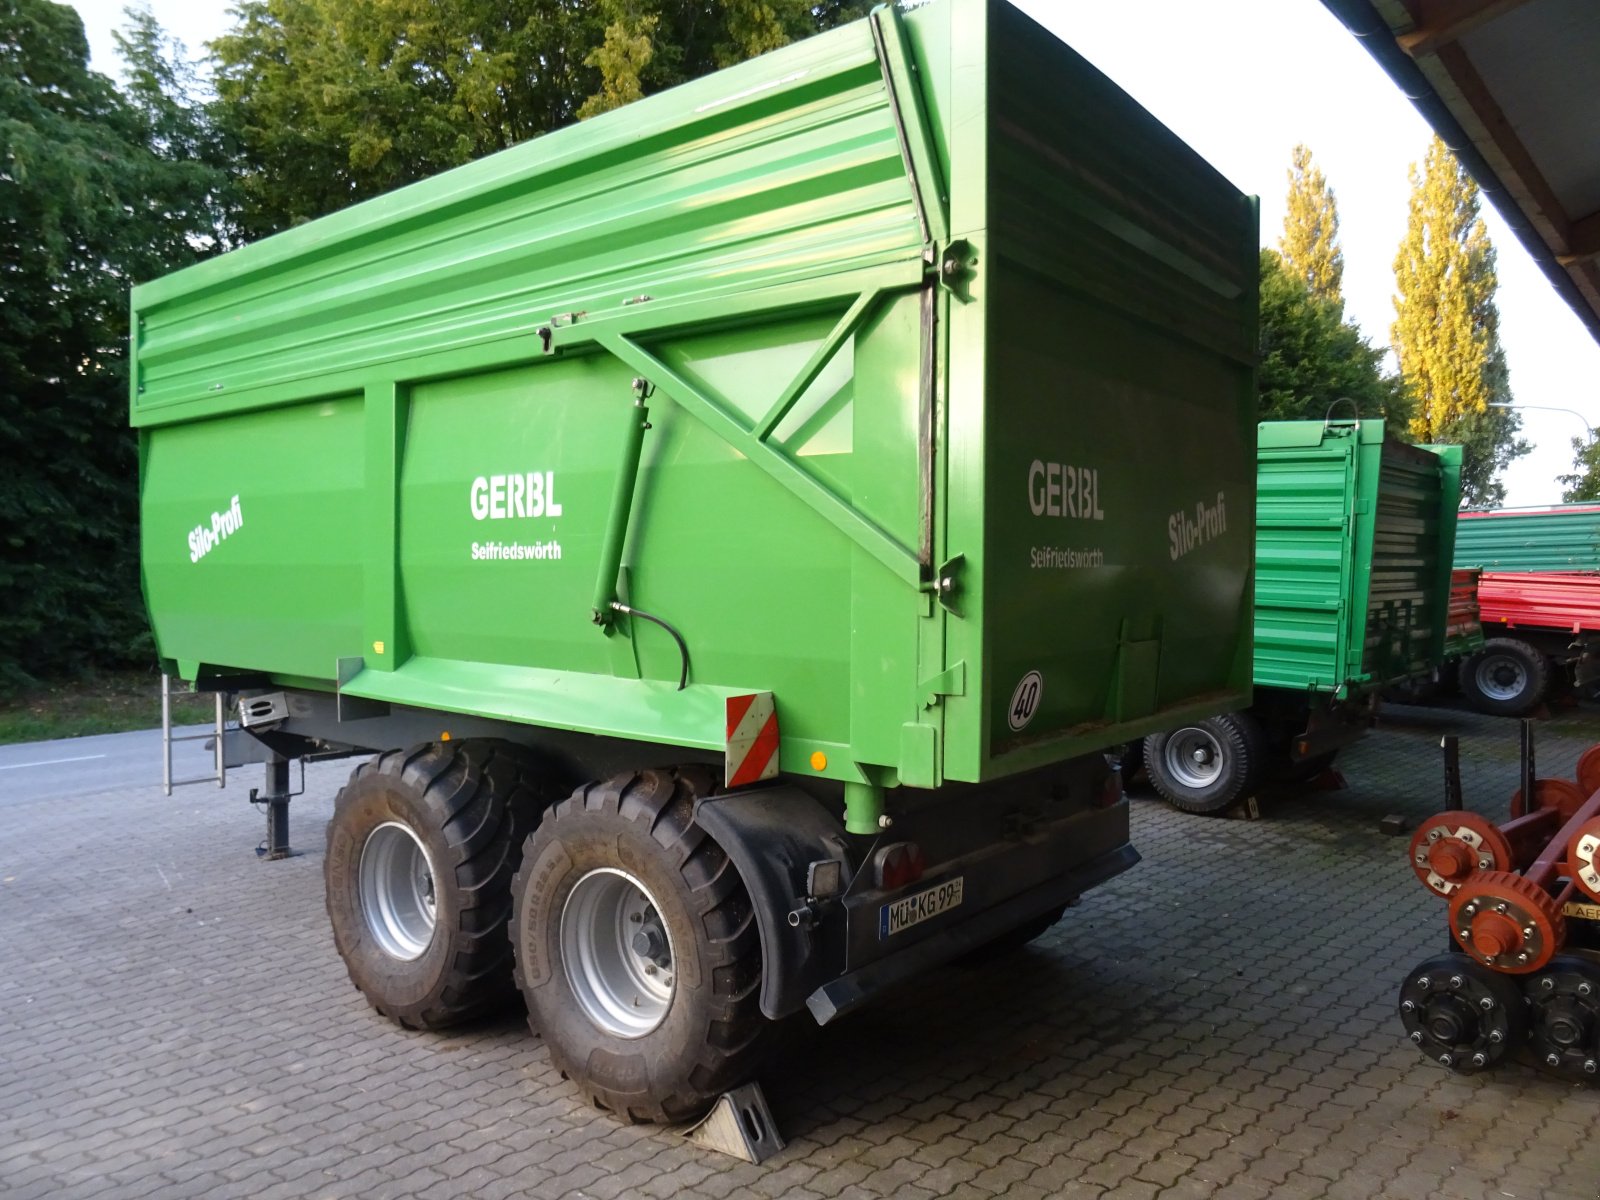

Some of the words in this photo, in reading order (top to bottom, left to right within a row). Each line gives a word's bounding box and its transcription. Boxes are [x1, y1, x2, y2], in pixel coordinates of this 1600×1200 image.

[470, 471, 562, 520] GERBL
[1028, 459, 1104, 521] GERBL
[188, 494, 243, 563] Silo-Profi
[471, 540, 562, 560] Seifriedswörth
[1168, 491, 1226, 561] Silo-Profi
[1030, 546, 1104, 568] Seifriedswörth
[1013, 682, 1038, 720] 40
[890, 901, 909, 931] MÜ
[918, 891, 936, 919] KG
[938, 883, 954, 910] 99
